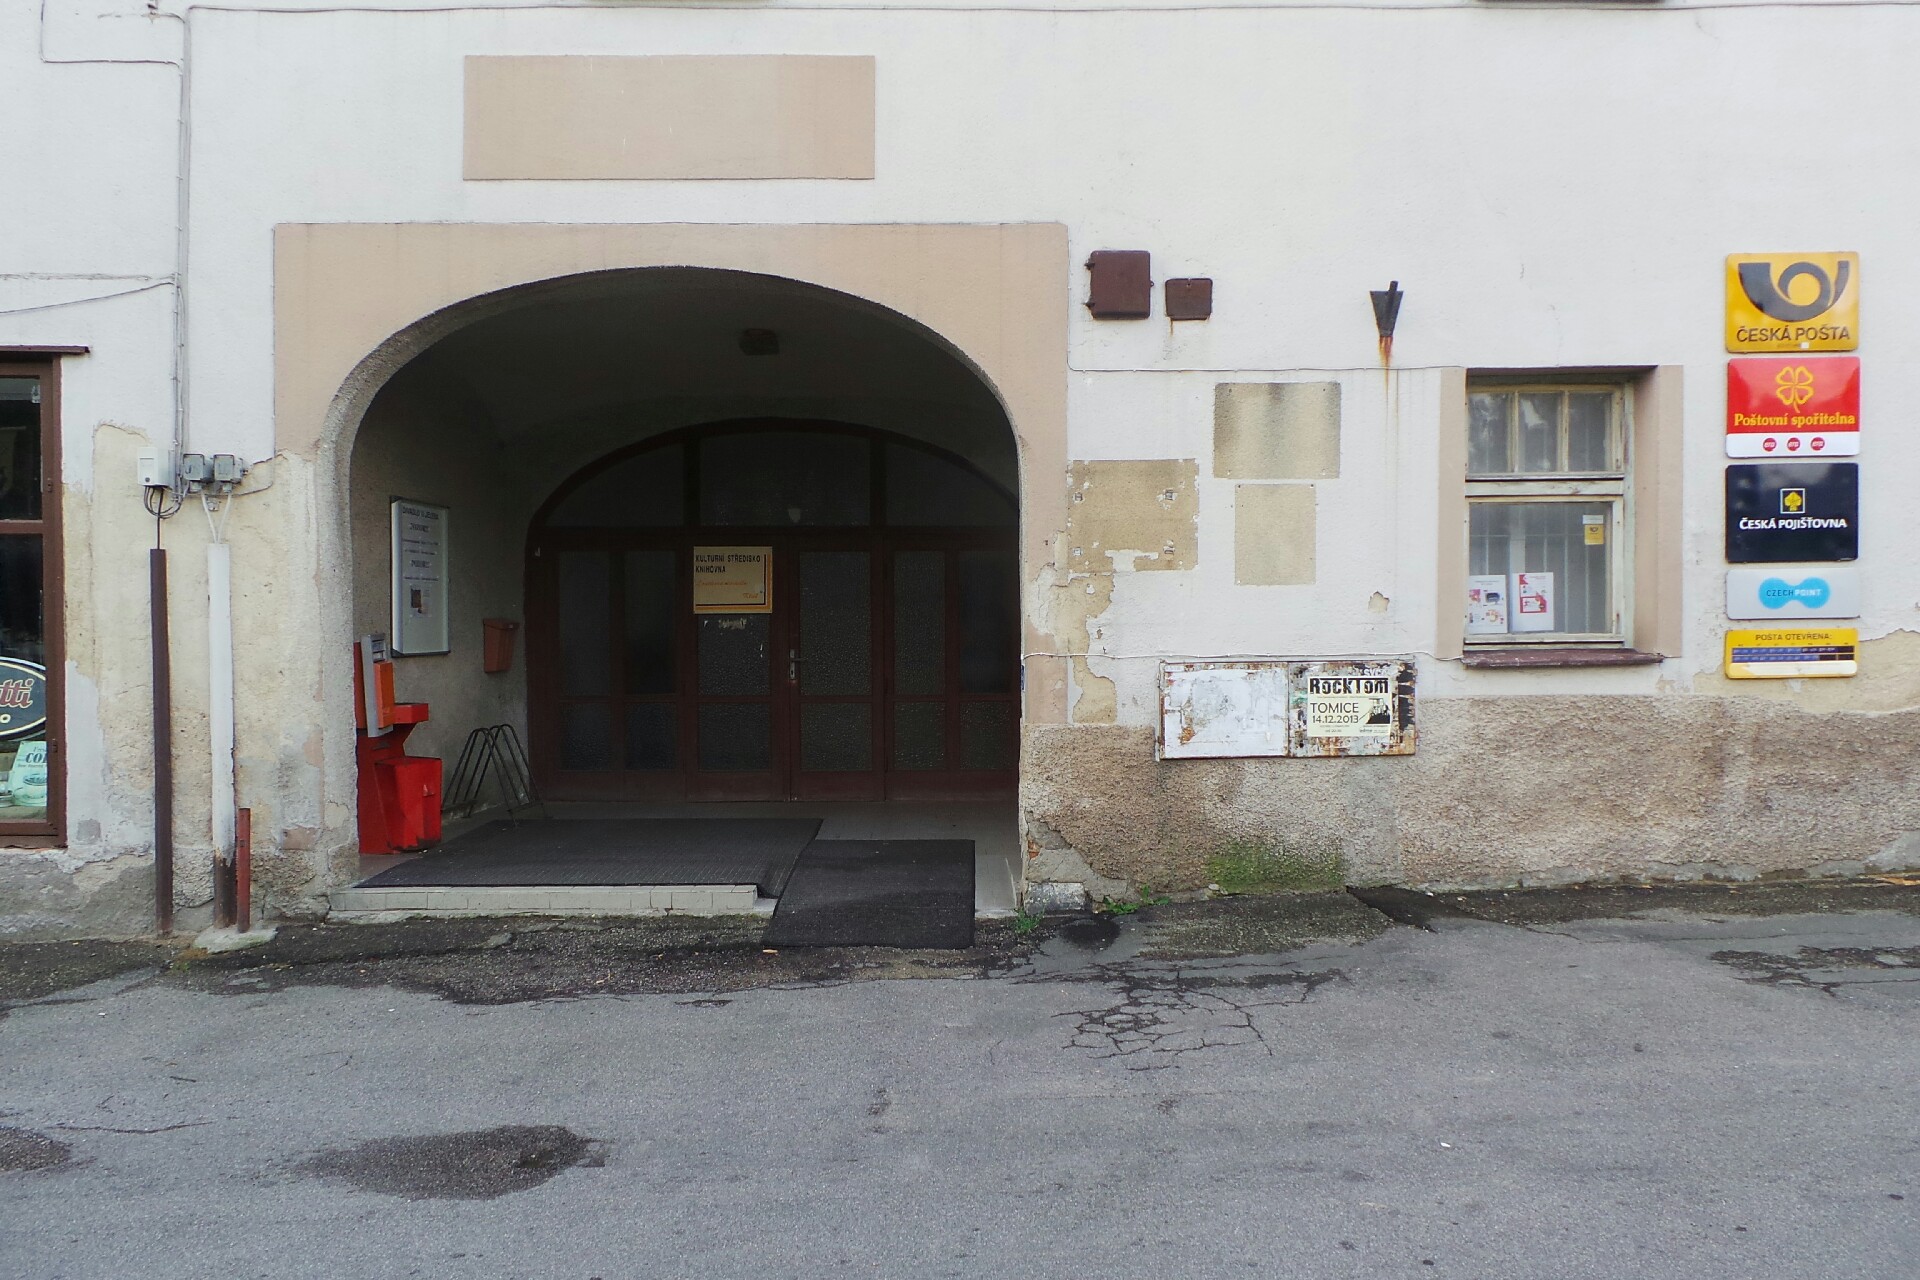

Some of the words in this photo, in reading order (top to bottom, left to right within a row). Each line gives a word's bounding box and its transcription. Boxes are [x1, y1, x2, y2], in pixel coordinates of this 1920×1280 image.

[1736, 325, 1791, 342] ČESKÁ
[1795, 323, 1850, 340] POŠTA
[1734, 413, 1788, 426] Poštovní
[1791, 412, 1855, 428] spořitelna
[1739, 517, 1776, 529] ČESKÁ
[1778, 516, 1847, 530] POJIŠŤOVNA
[695, 554, 724, 563] KULTURNÍ
[727, 554, 761, 563] STŘEDISKO
[695, 565, 726, 574] KNIHOVNA
[1766, 589, 1794, 597] CZECH
[1795, 588, 1821, 596] POINT
[1755, 633, 1783, 641] POŠTA
[1310, 702, 1359, 714] TOMICE
[1312, 715, 1359, 724] 14.12.2013
